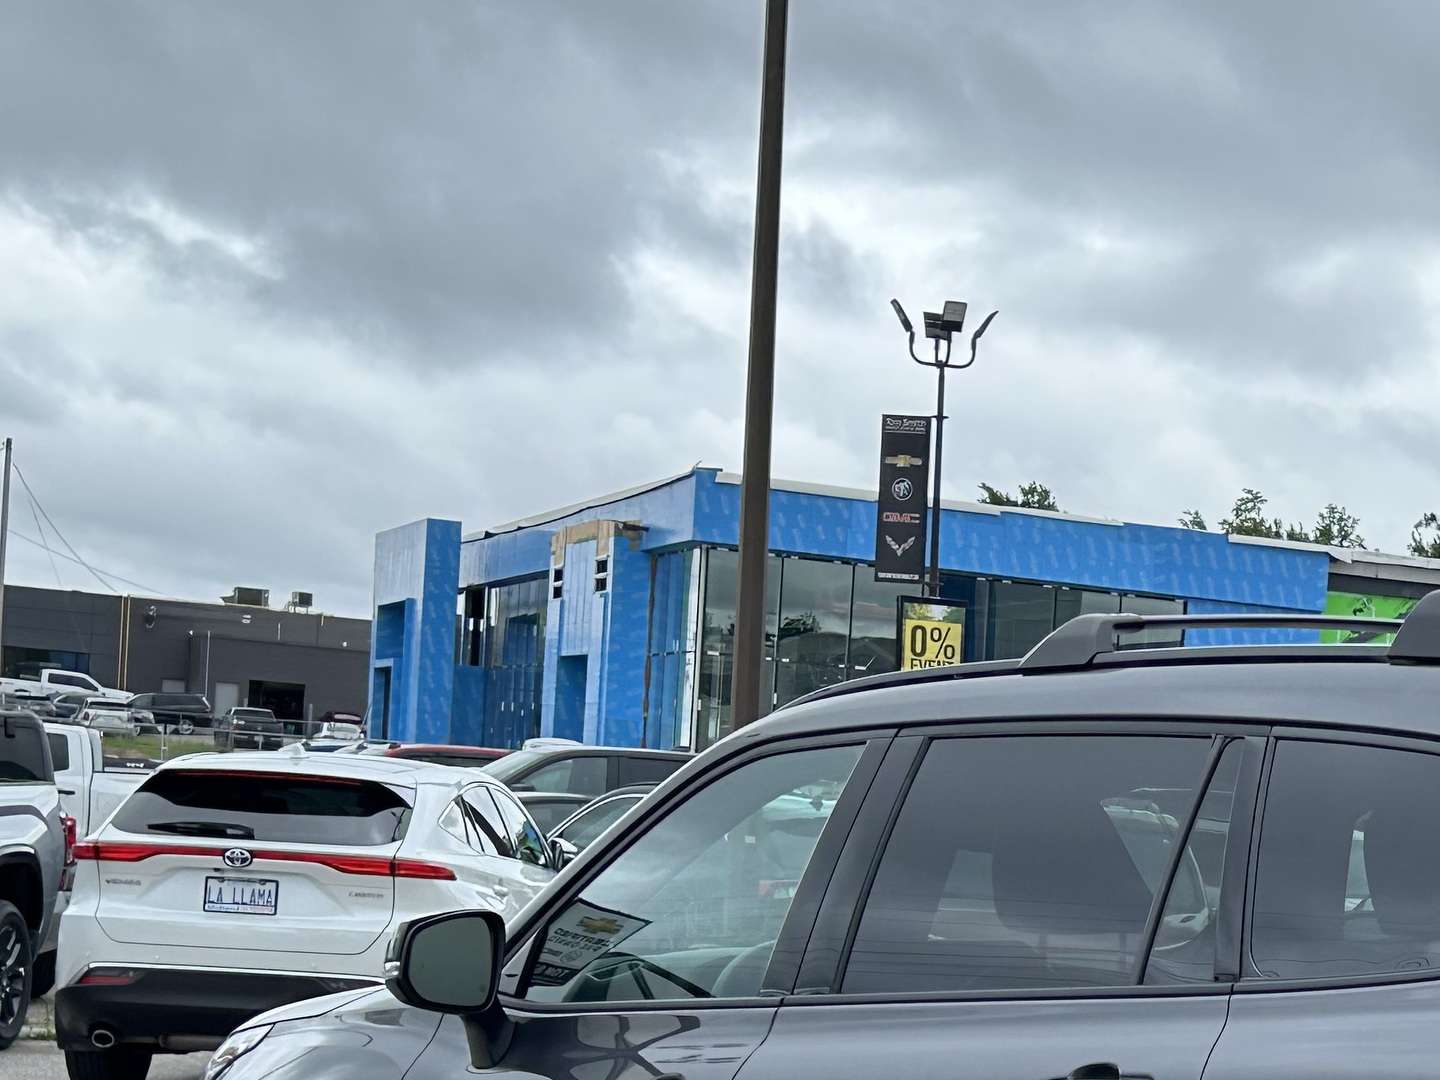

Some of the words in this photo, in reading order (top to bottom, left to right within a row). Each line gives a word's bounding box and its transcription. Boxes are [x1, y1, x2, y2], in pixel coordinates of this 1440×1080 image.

[910, 624, 956, 660] 0%
[207, 885, 223, 904] LA
[232, 887, 274, 907] LLAMA
